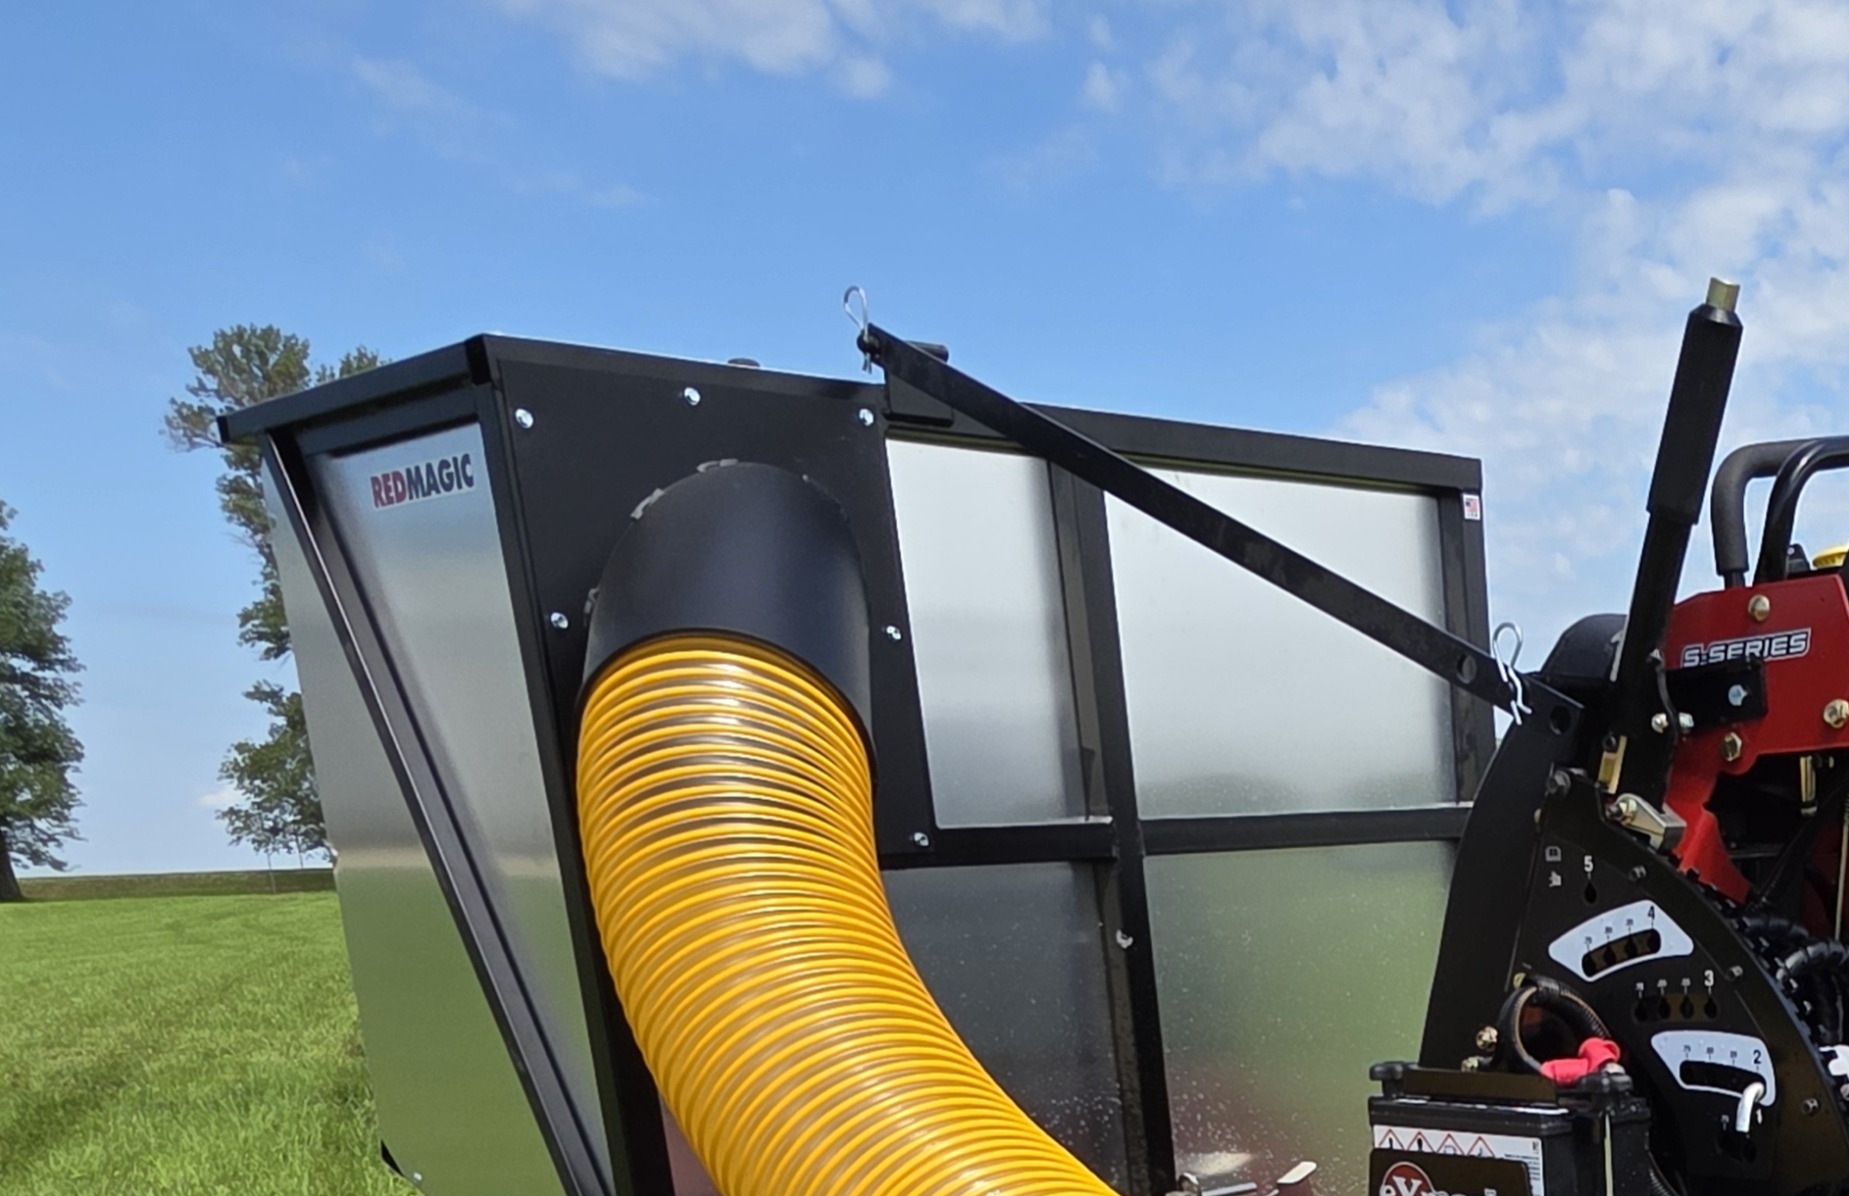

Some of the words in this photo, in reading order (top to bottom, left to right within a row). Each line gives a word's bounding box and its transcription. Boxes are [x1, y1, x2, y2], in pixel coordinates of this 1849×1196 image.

[370, 453, 475, 508] REDMAGIC
[1583, 856, 1593, 872] 5
[1647, 906, 1655, 920] 4
[1704, 970, 1714, 987] 3
[1752, 1049, 1762, 1065] 2
